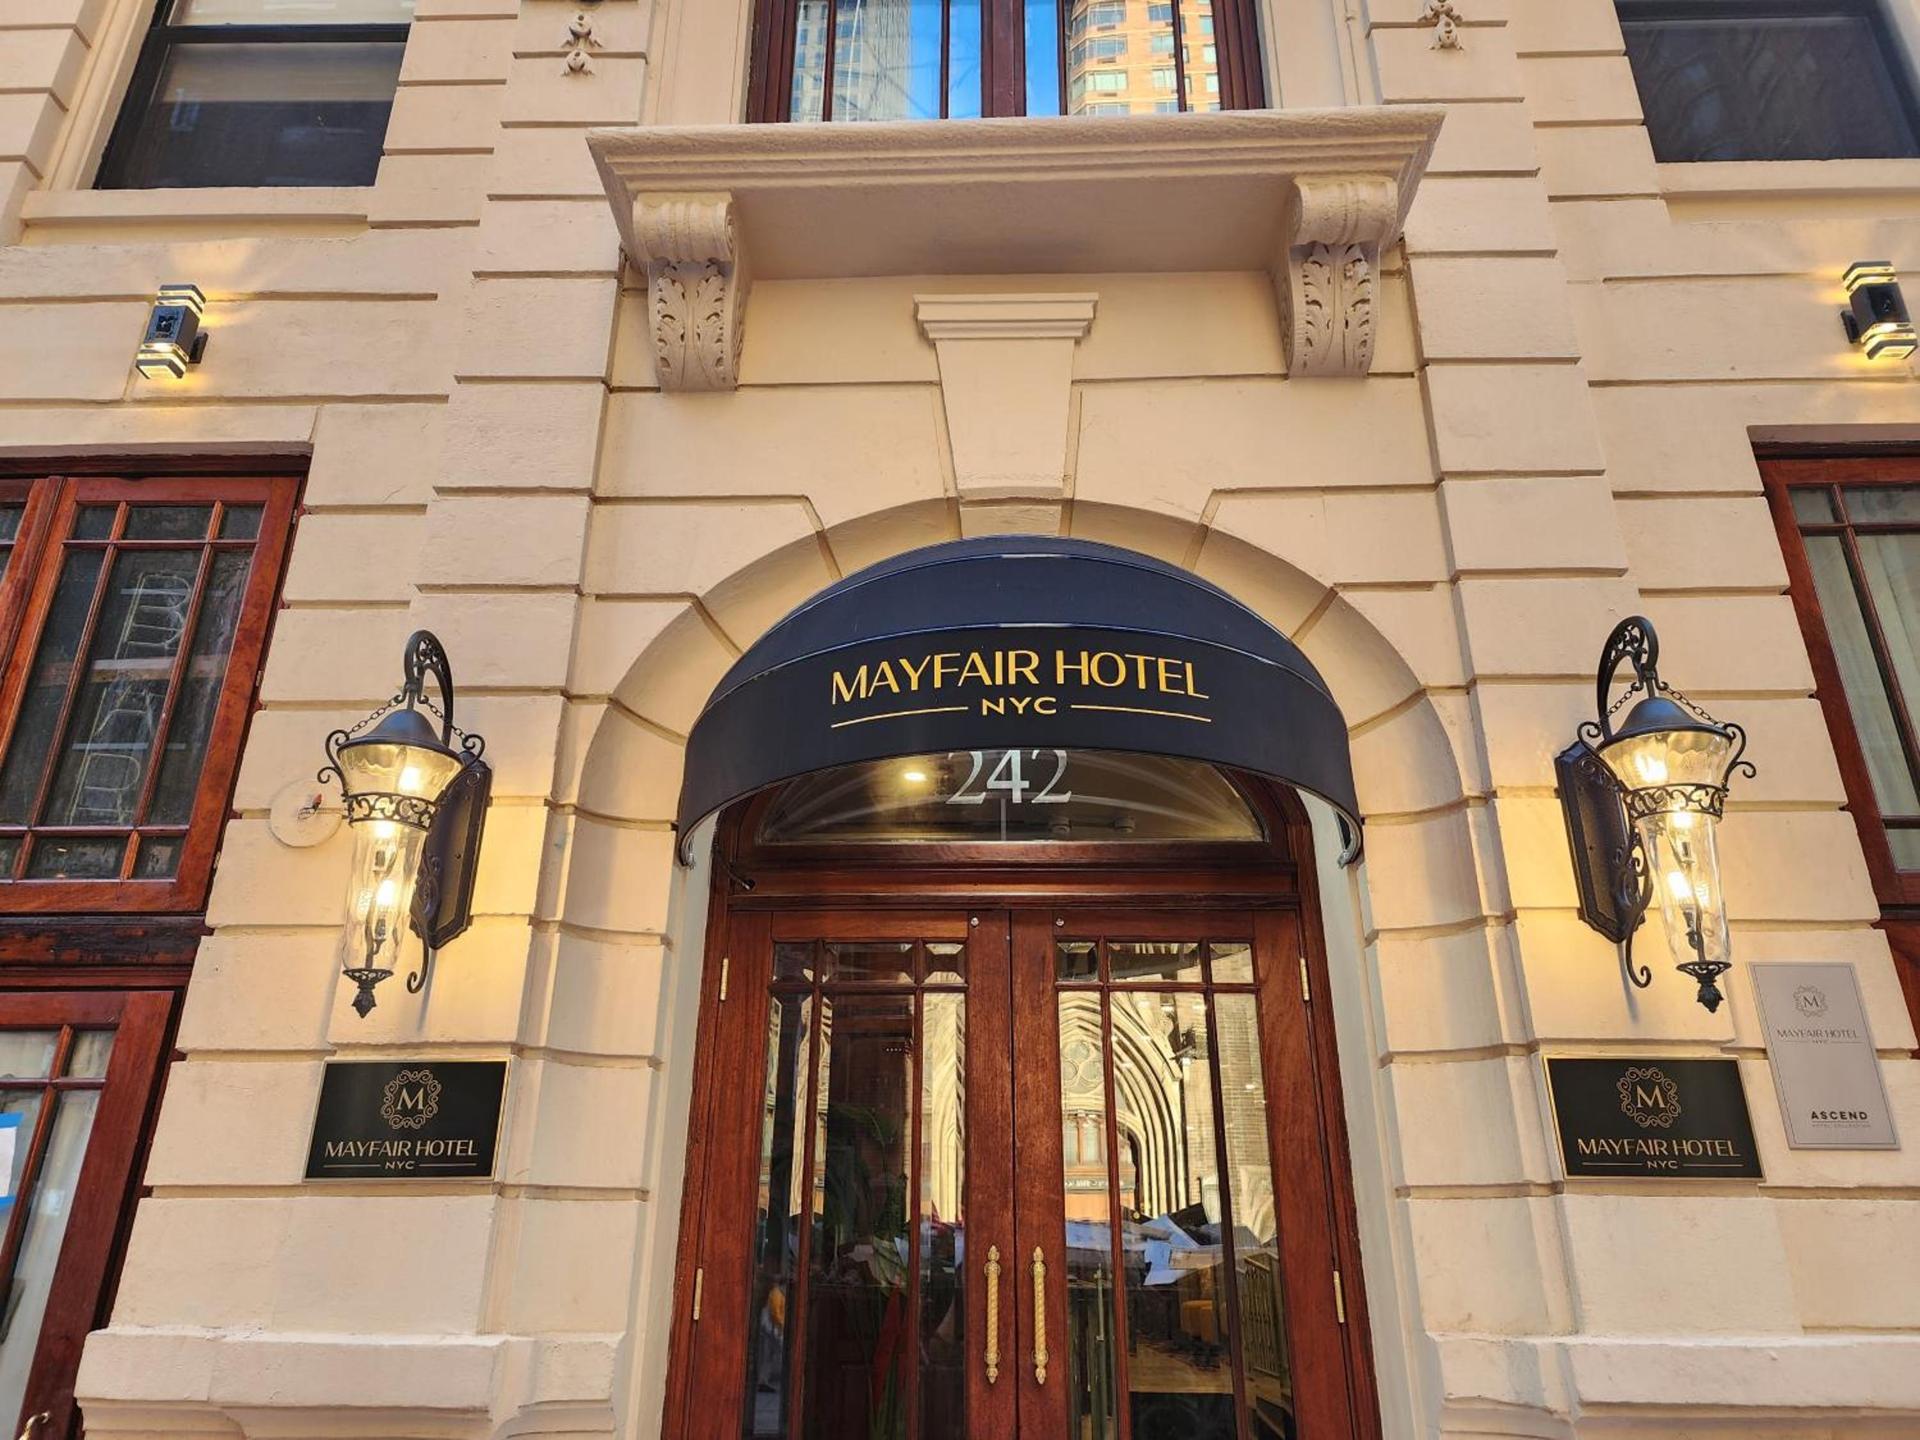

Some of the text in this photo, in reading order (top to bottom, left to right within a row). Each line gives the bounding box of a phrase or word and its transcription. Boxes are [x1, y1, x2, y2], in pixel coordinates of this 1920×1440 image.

[831, 649, 1210, 705] MAYFAIR HOTEL
[981, 696, 1058, 716] NYC
[945, 749, 1073, 805] 242
[1802, 994, 1820, 1008] M
[1776, 1028, 1823, 1039] MAYFAIR
[396, 1087, 425, 1110] M
[1636, 1084, 1667, 1109] M
[1810, 1110, 1869, 1120] ASCEND
[324, 1138, 479, 1158] MAYFAIR HOTEL
[1577, 1137, 1741, 1157] MAYFAIR HOTEL
[385, 1160, 416, 1170] NYC
[1646, 1160, 1679, 1170] NYC
